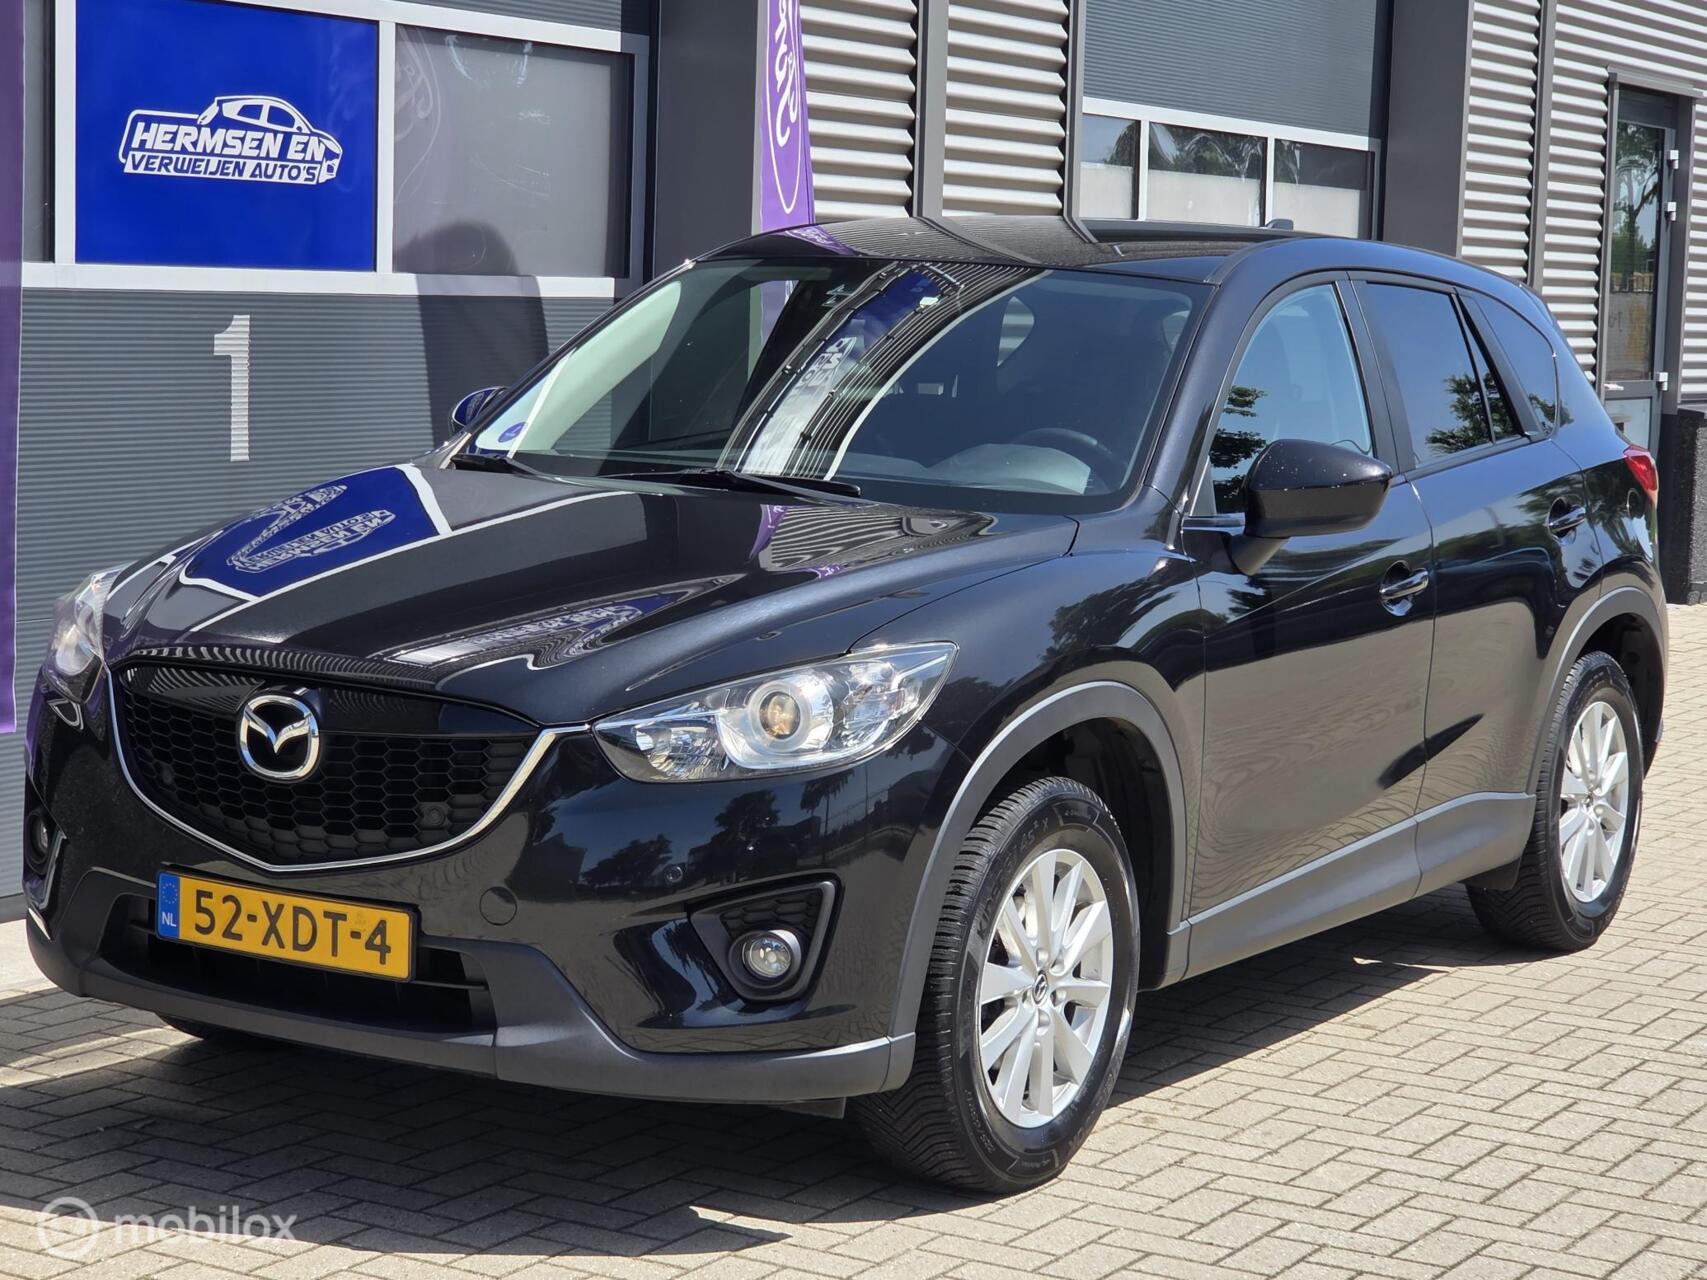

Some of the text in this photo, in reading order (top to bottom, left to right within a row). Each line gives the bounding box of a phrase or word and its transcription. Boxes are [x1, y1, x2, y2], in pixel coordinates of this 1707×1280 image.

[130, 121, 326, 162] HERMSEN EN
[131, 152, 318, 183] VERWEIJEN AUTO'S
[213, 314, 250, 462] 1
[161, 912, 178, 928] NL
[194, 888, 392, 966] 52-XDT-4
